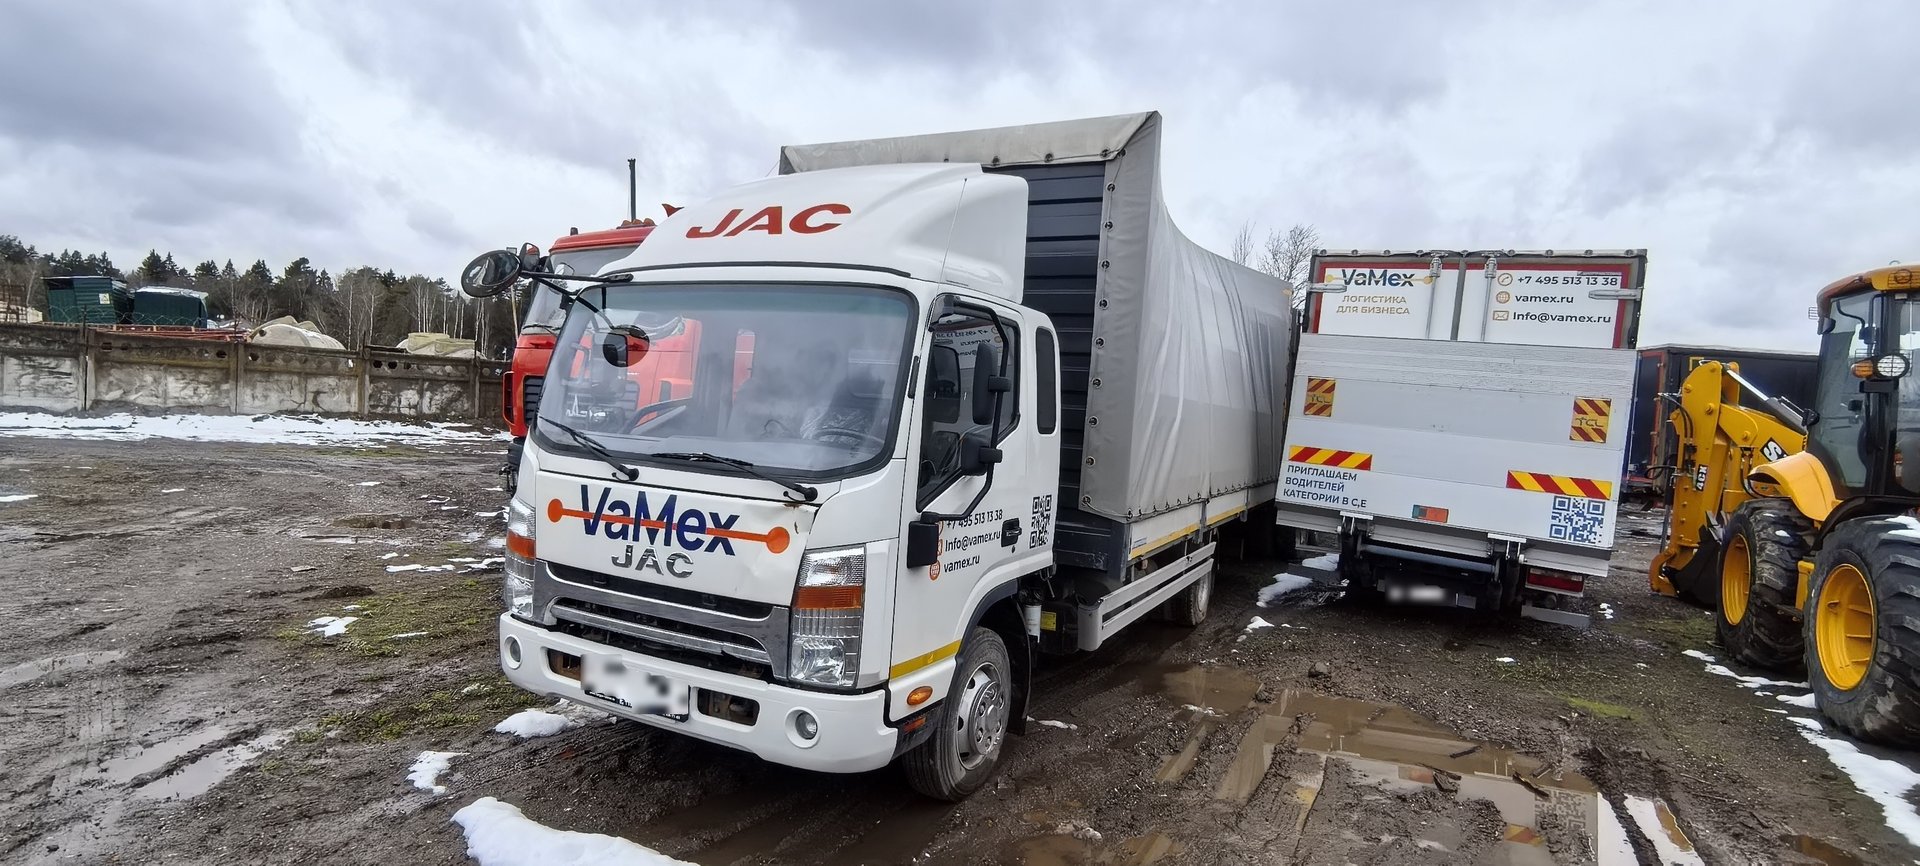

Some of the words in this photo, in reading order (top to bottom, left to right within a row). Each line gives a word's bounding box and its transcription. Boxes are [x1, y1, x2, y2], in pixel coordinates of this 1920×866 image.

[685, 203, 852, 239] JAC
[1341, 269, 1416, 287] VaMex
[1517, 276, 1532, 285] +7
[1535, 276, 1559, 285] 495
[1562, 276, 1582, 286] 513
[1585, 277, 1598, 286] 13
[1601, 277, 1618, 286] 38
[1342, 295, 1407, 304] ЛОГИСТИКА
[1515, 294, 1575, 304] vamex.ru
[1336, 305, 1359, 314] ДЛЯ
[1360, 306, 1411, 315] БИЗНЕСА
[1512, 311, 1612, 324] Info@vamex.ru
[1575, 417, 1604, 428] TCL
[1287, 464, 1358, 482] ПРИГЛАШАЕМ
[1285, 476, 1345, 492] ВОДИТЕЛЕЙ
[1283, 488, 1340, 504] КАТЕГОРИИ
[580, 484, 741, 557] VaMex
[958, 514, 973, 528] 495
[974, 511, 986, 526] 513
[986, 510, 994, 523] 13
[994, 509, 1003, 521] 38
[945, 530, 1001, 552] Info@vamex.ru
[611, 544, 695, 579] JAC
[944, 555, 981, 573] vamex.ru
